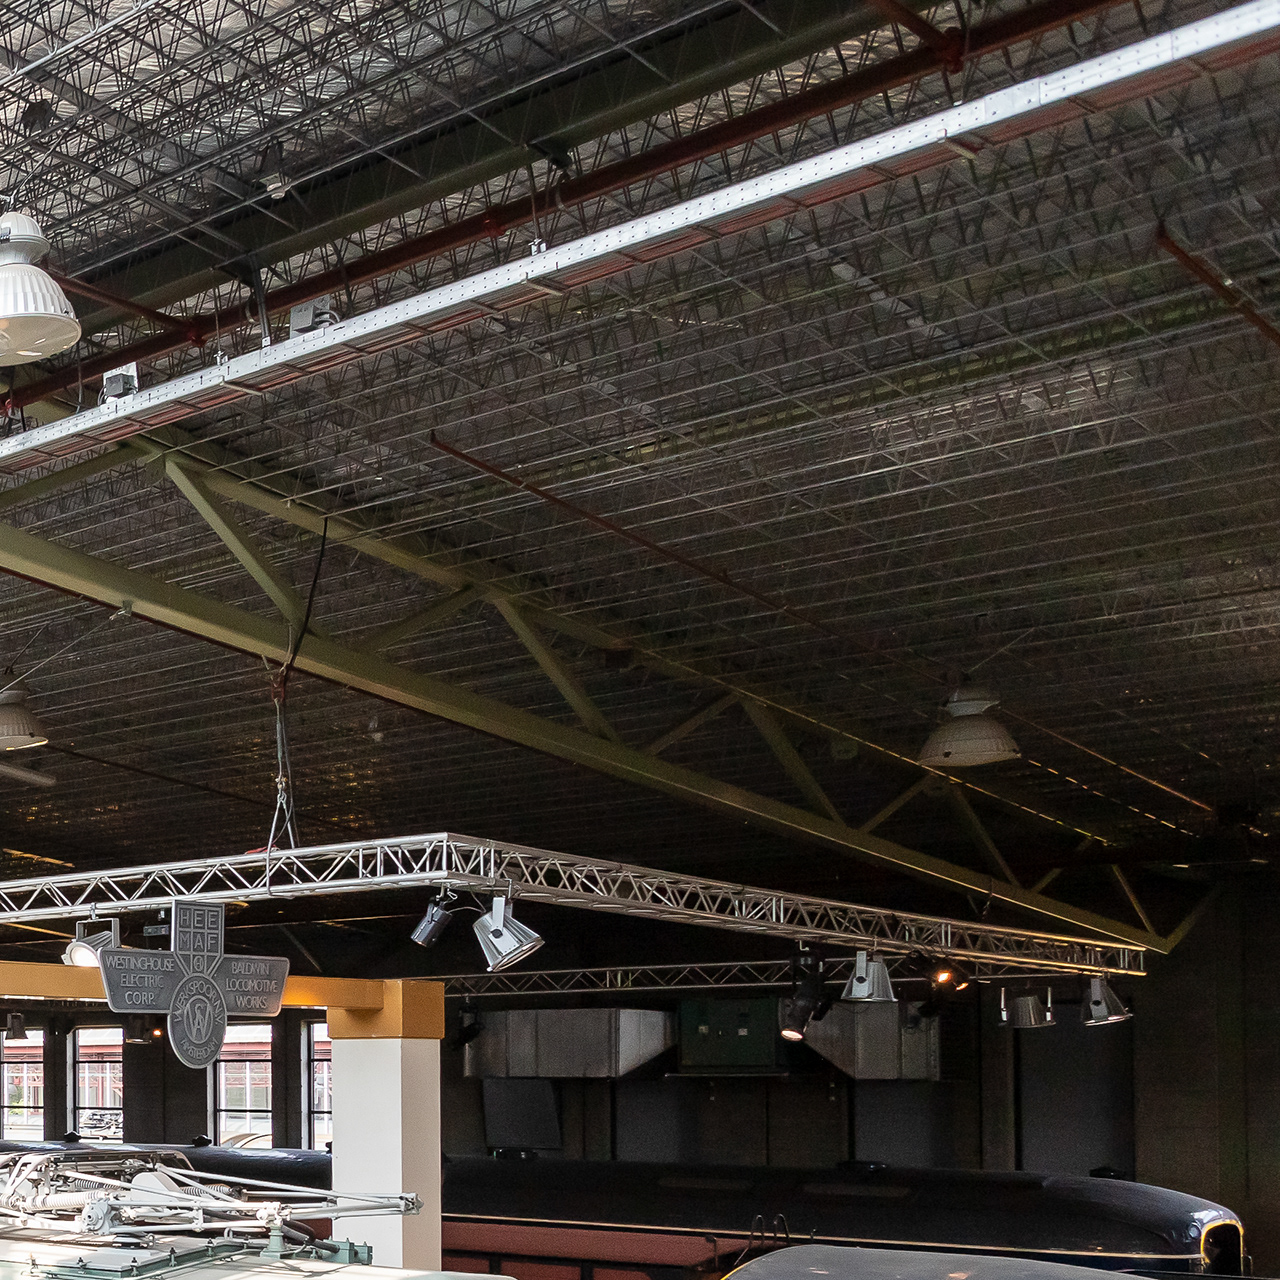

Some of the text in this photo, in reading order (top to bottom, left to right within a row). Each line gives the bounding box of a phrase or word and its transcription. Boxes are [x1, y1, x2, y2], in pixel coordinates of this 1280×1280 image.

[106, 956, 175, 972] WESTINGHOUSE
[231, 961, 270, 975] BALDWIN
[121, 973, 164, 988] ELECTRIC
[225, 978, 279, 993] LOCOMOTIVE
[125, 991, 156, 1005] CORP.
[172, 980, 217, 1022] WERKSPOOR
[236, 995, 268, 1009] WORKS
